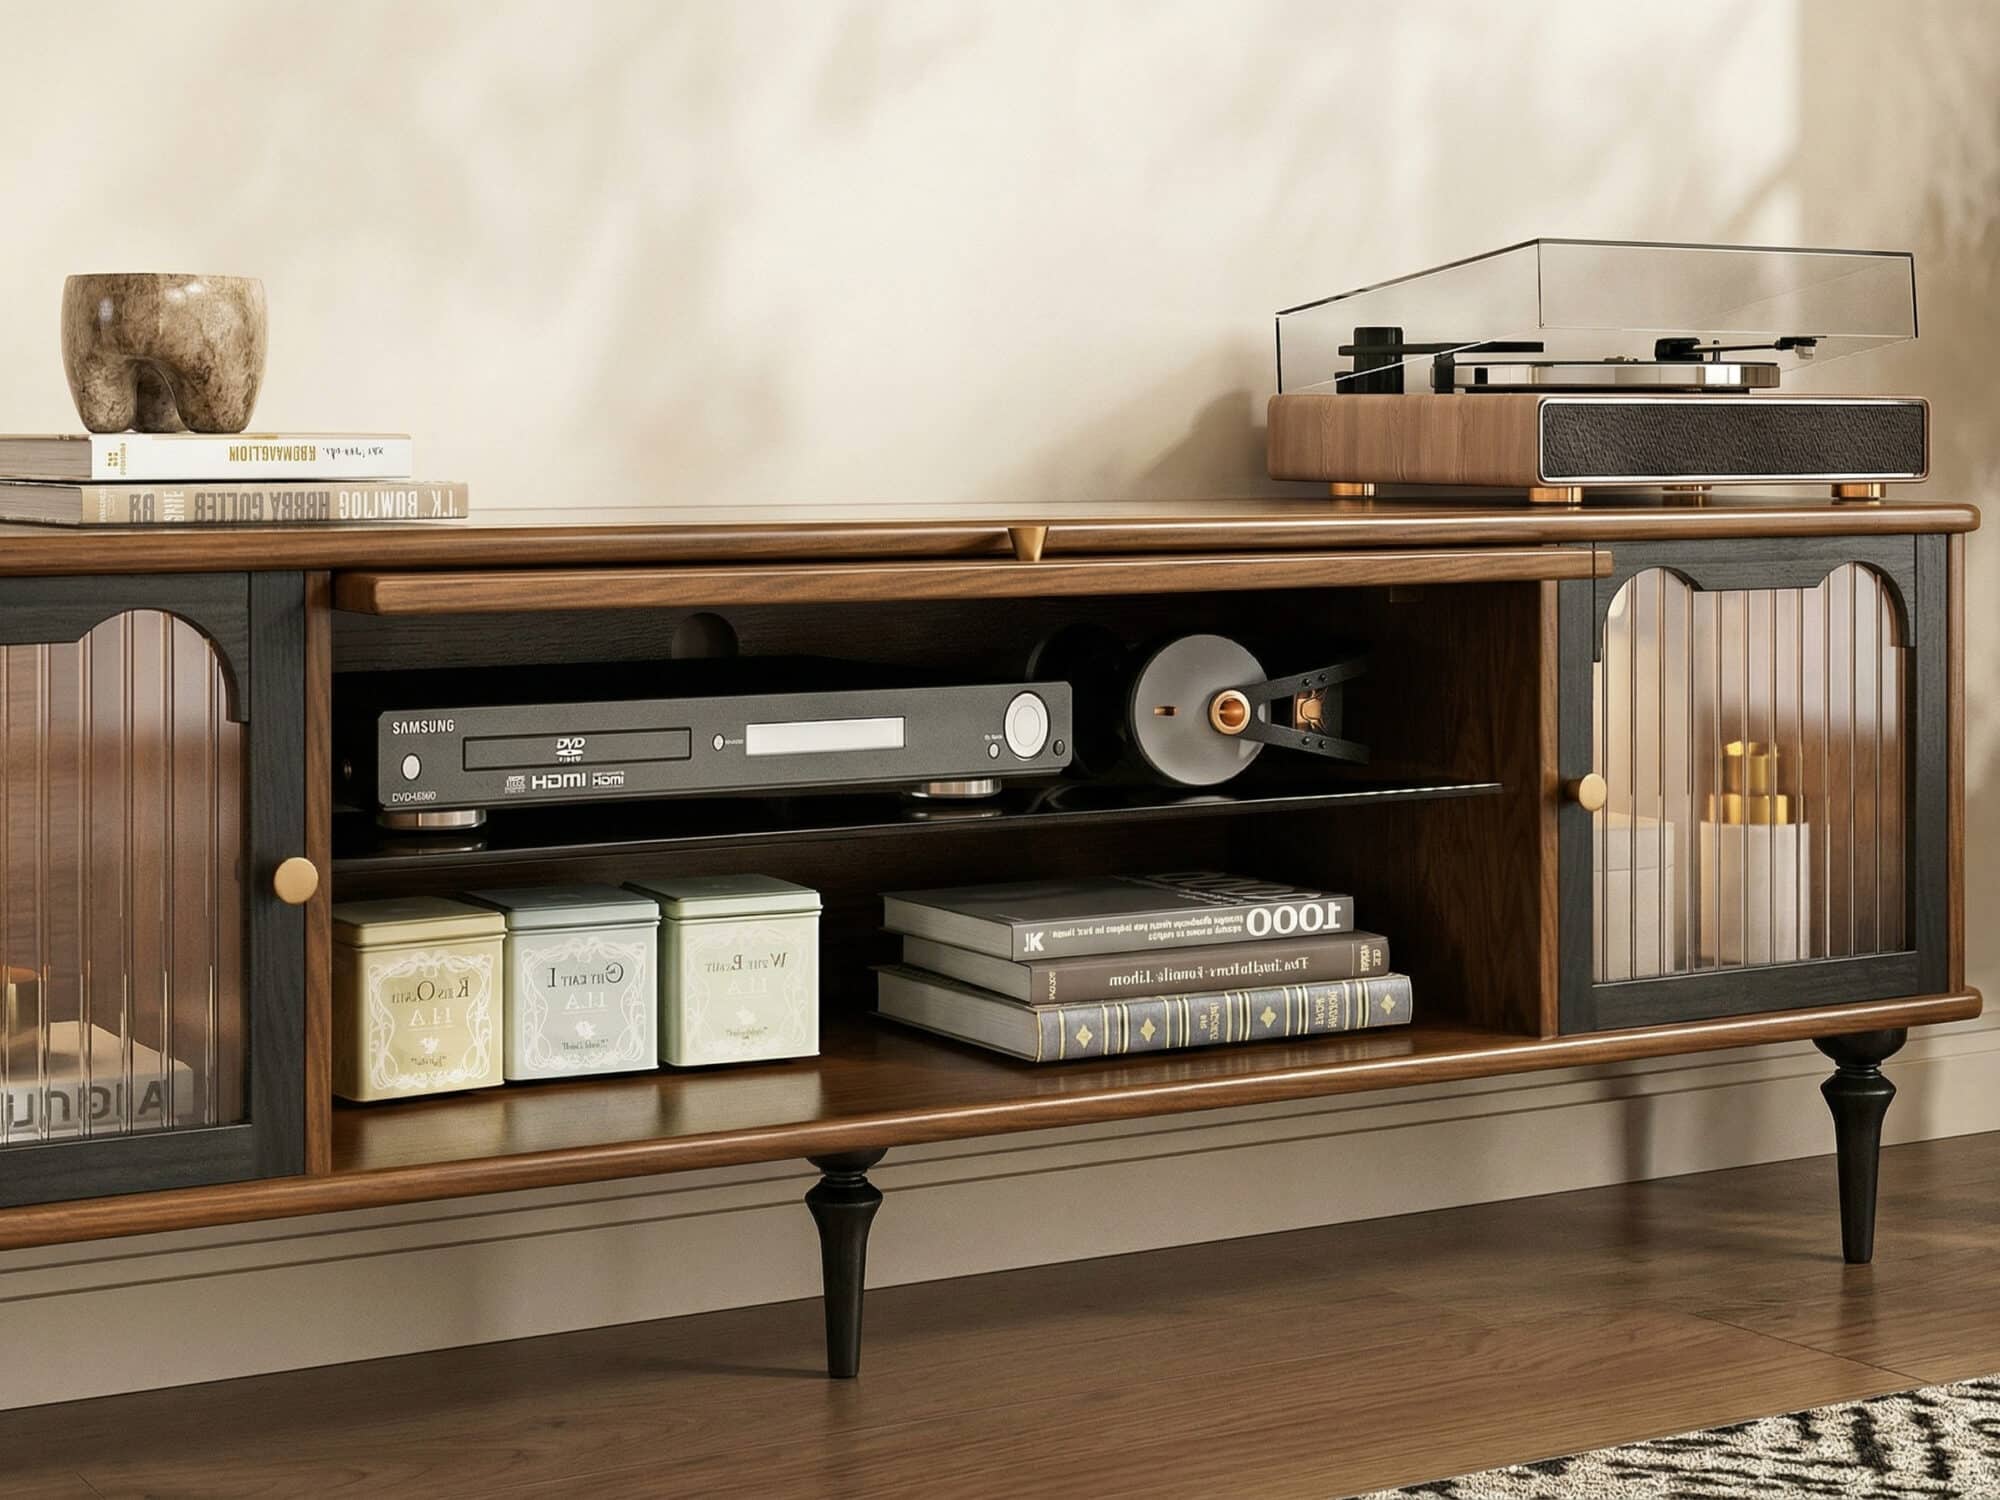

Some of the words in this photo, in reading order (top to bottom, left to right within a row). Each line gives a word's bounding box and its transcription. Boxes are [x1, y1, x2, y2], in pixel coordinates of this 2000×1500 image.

[392, 719, 455, 735] SAMSUNG
[556, 737, 586, 750] DVD
[531, 772, 587, 790] HDMI
